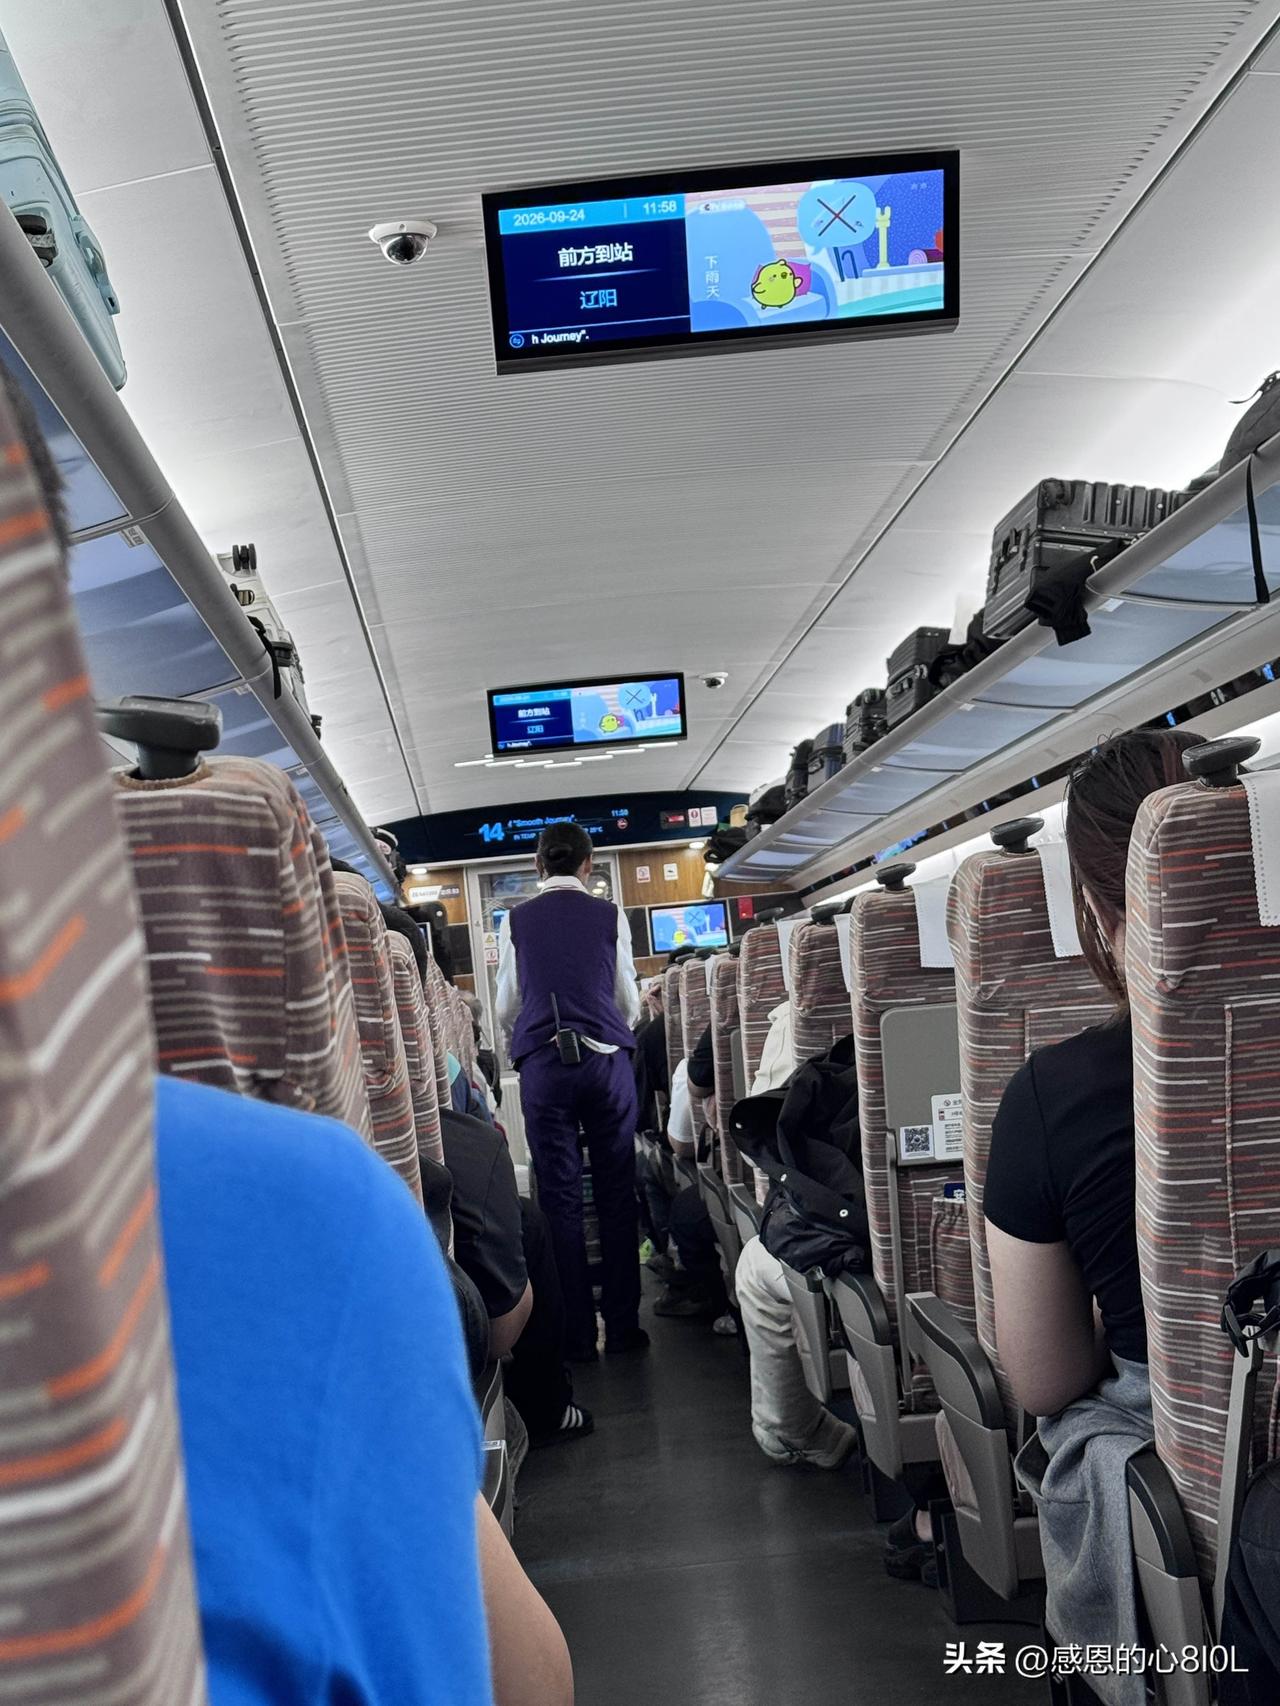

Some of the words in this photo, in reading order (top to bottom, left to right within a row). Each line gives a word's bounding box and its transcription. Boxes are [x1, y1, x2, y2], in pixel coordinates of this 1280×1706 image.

[513, 208, 585, 227] 2026-09-24
[643, 200, 677, 215] 11:58
[558, 242, 634, 268] 前方到站
[704, 255, 721, 299] 下雨天
[579, 288, 618, 309] 辽阳
[531, 334, 540, 345] h
[479, 822, 505, 842] 14
